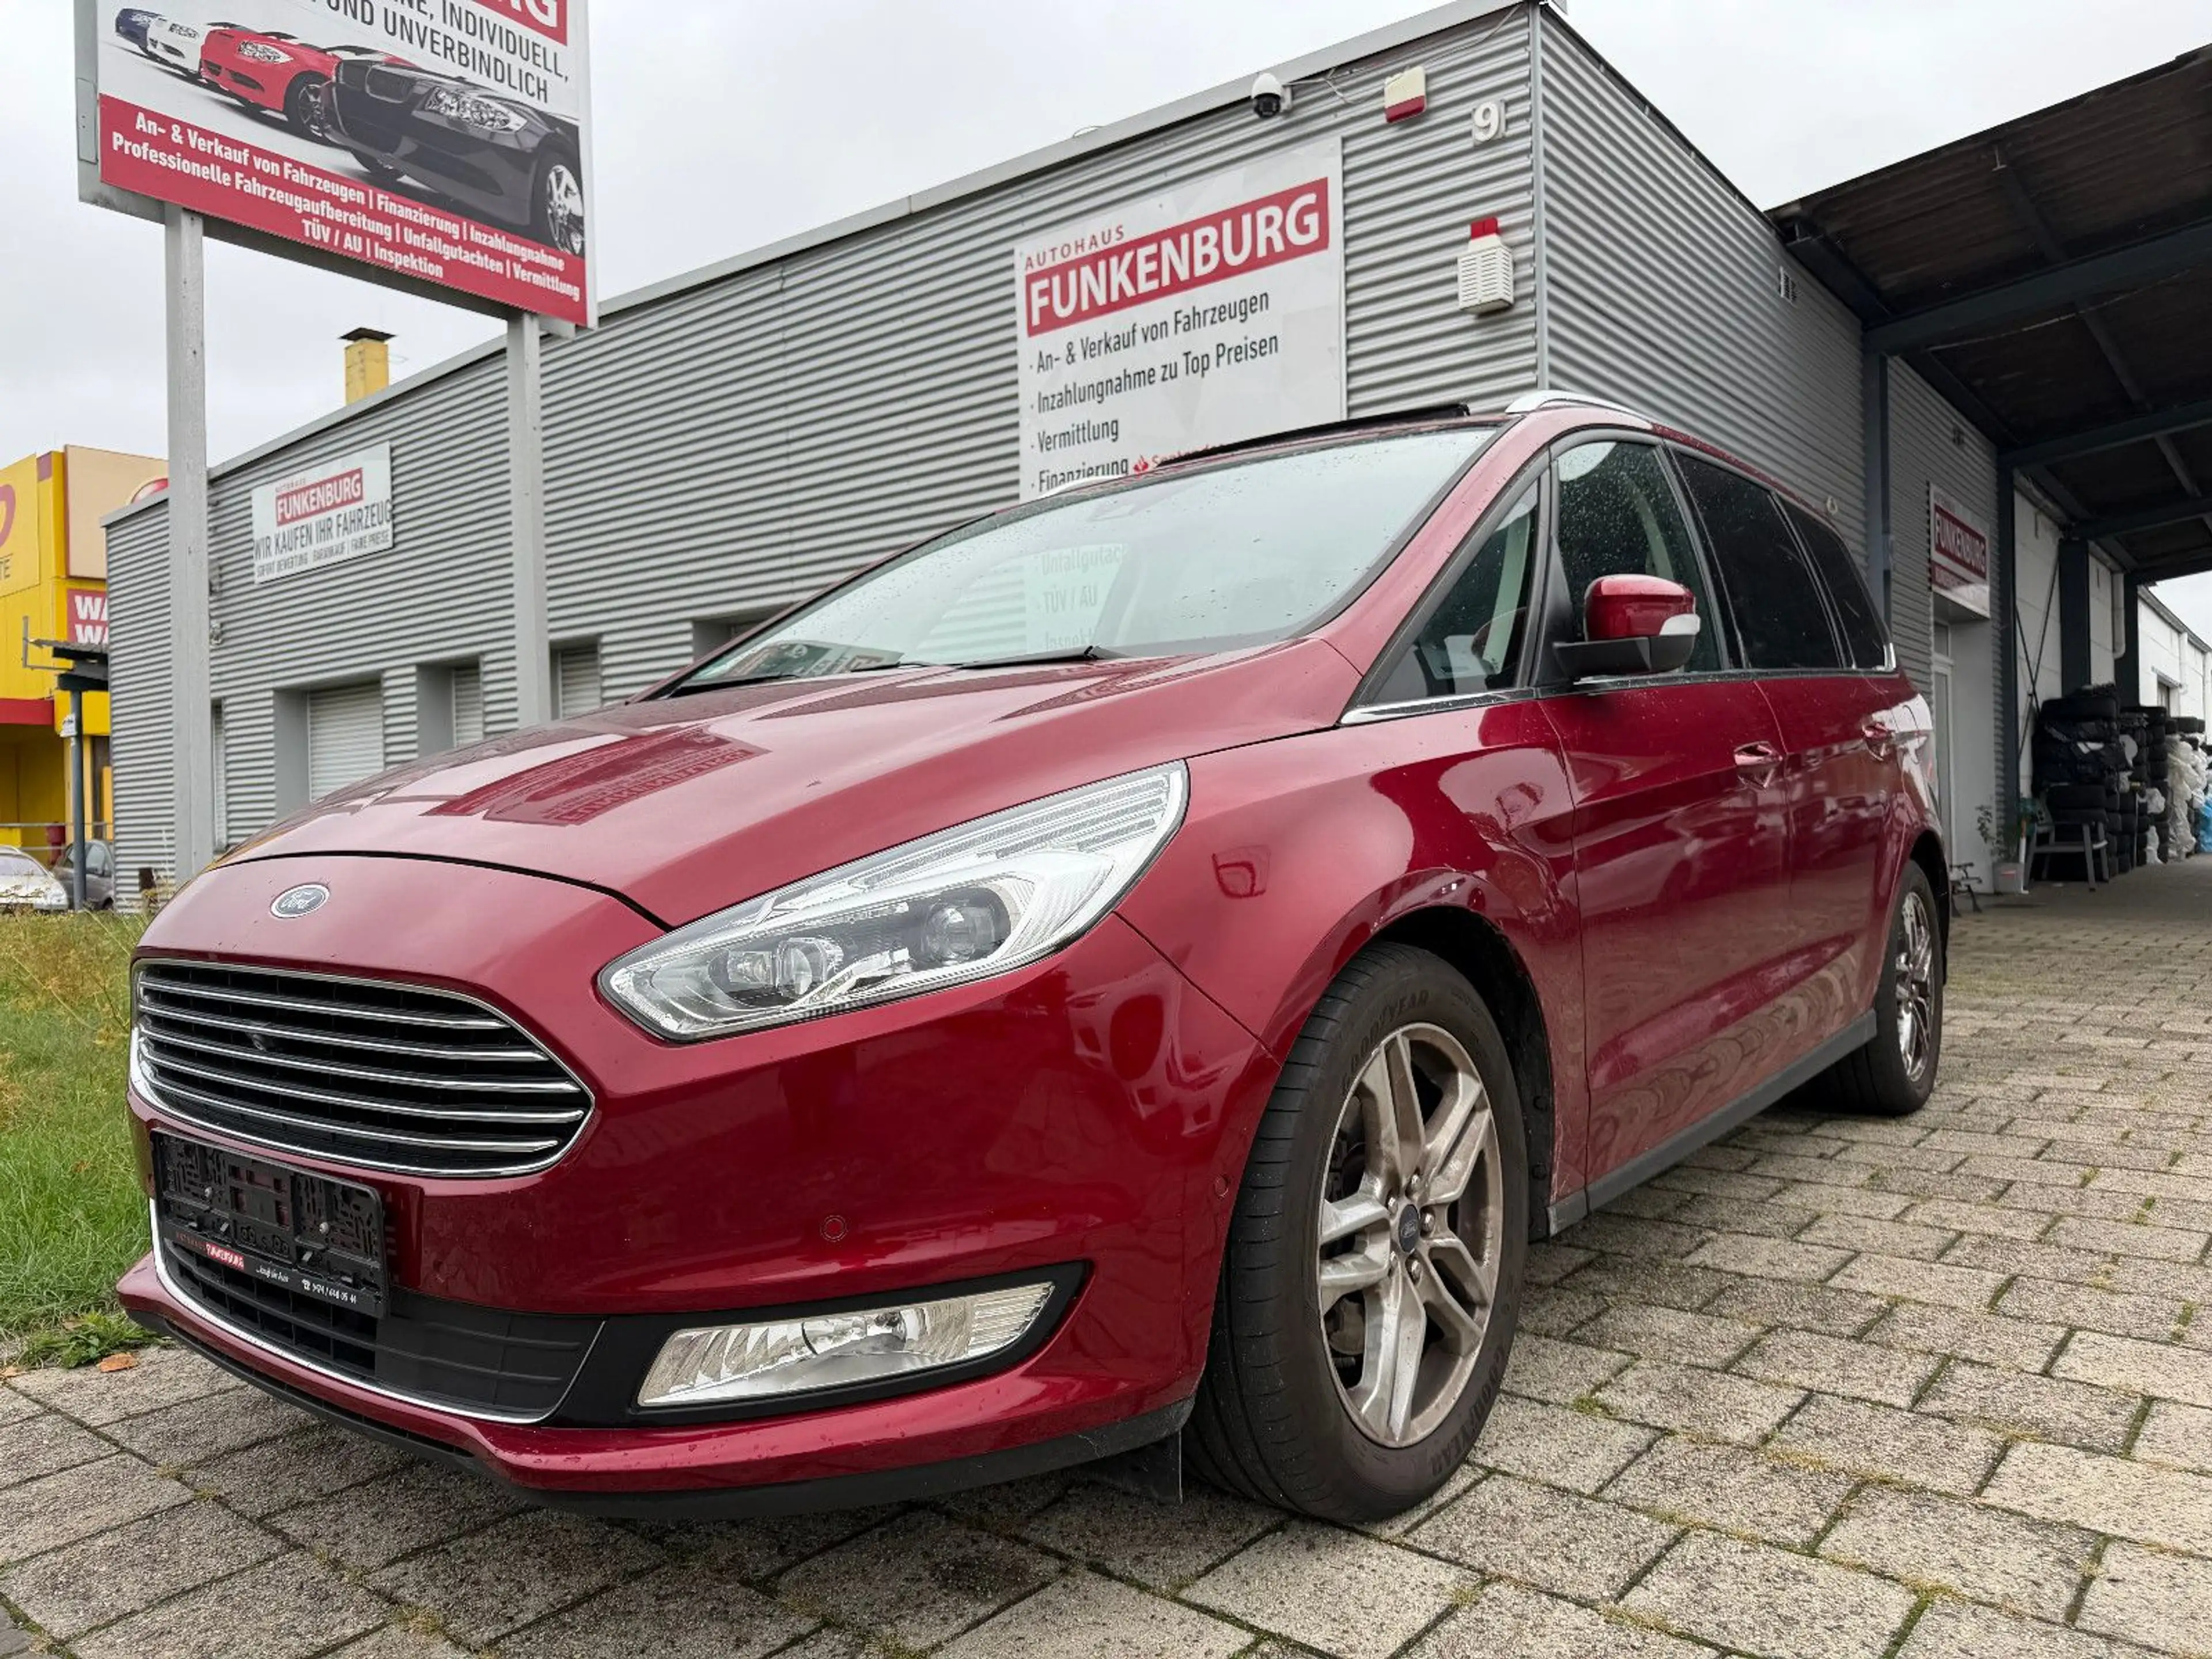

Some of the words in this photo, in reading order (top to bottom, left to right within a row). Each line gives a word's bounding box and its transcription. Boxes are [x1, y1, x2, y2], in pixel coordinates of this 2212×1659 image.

[384, 7, 548, 103] UNVERBINDLICH
[1473, 101, 1499, 142] 9
[112, 131, 231, 187] Professionelle
[235, 172, 392, 238] Fahrzeugaufbereitung
[403, 225, 504, 274] Unfallgutachten
[513, 263, 581, 302] Vermittlung
[135, 112, 166, 137] An-
[171, 124, 184, 144] &
[187, 128, 250, 166] Verkauf
[252, 154, 281, 176] von
[283, 162, 365, 204] Fahrzeugen
[377, 193, 460, 237] Finanzierung
[470, 226, 566, 272] Inzahlungnahme
[301, 217, 331, 244] TÜV
[343, 233, 363, 253] AU
[374, 241, 444, 279] Inspektion
[1024, 224, 1125, 272] AUTOHAUS
[1029, 192, 1320, 328] FUNKENBURG
[1037, 350, 1060, 374] An-
[1066, 341, 1077, 366] &
[1080, 323, 1138, 362] Verkauf
[1141, 320, 1169, 344] von
[1173, 291, 1270, 336] Fahrzeugen
[1037, 365, 1157, 414] Inzahlungnahme
[1161, 361, 1178, 382] zu
[1183, 350, 1211, 379] Top
[1215, 335, 1279, 369] Preisen
[1037, 419, 1119, 453] Vermittlung
[277, 472, 362, 523] FUNKENBURG
[253, 535, 275, 565] WIR
[274, 522, 312, 555] KAUFEN
[315, 516, 334, 544] IHR
[336, 498, 392, 539] FAHRZEUG
[74, 623, 108, 646] W
